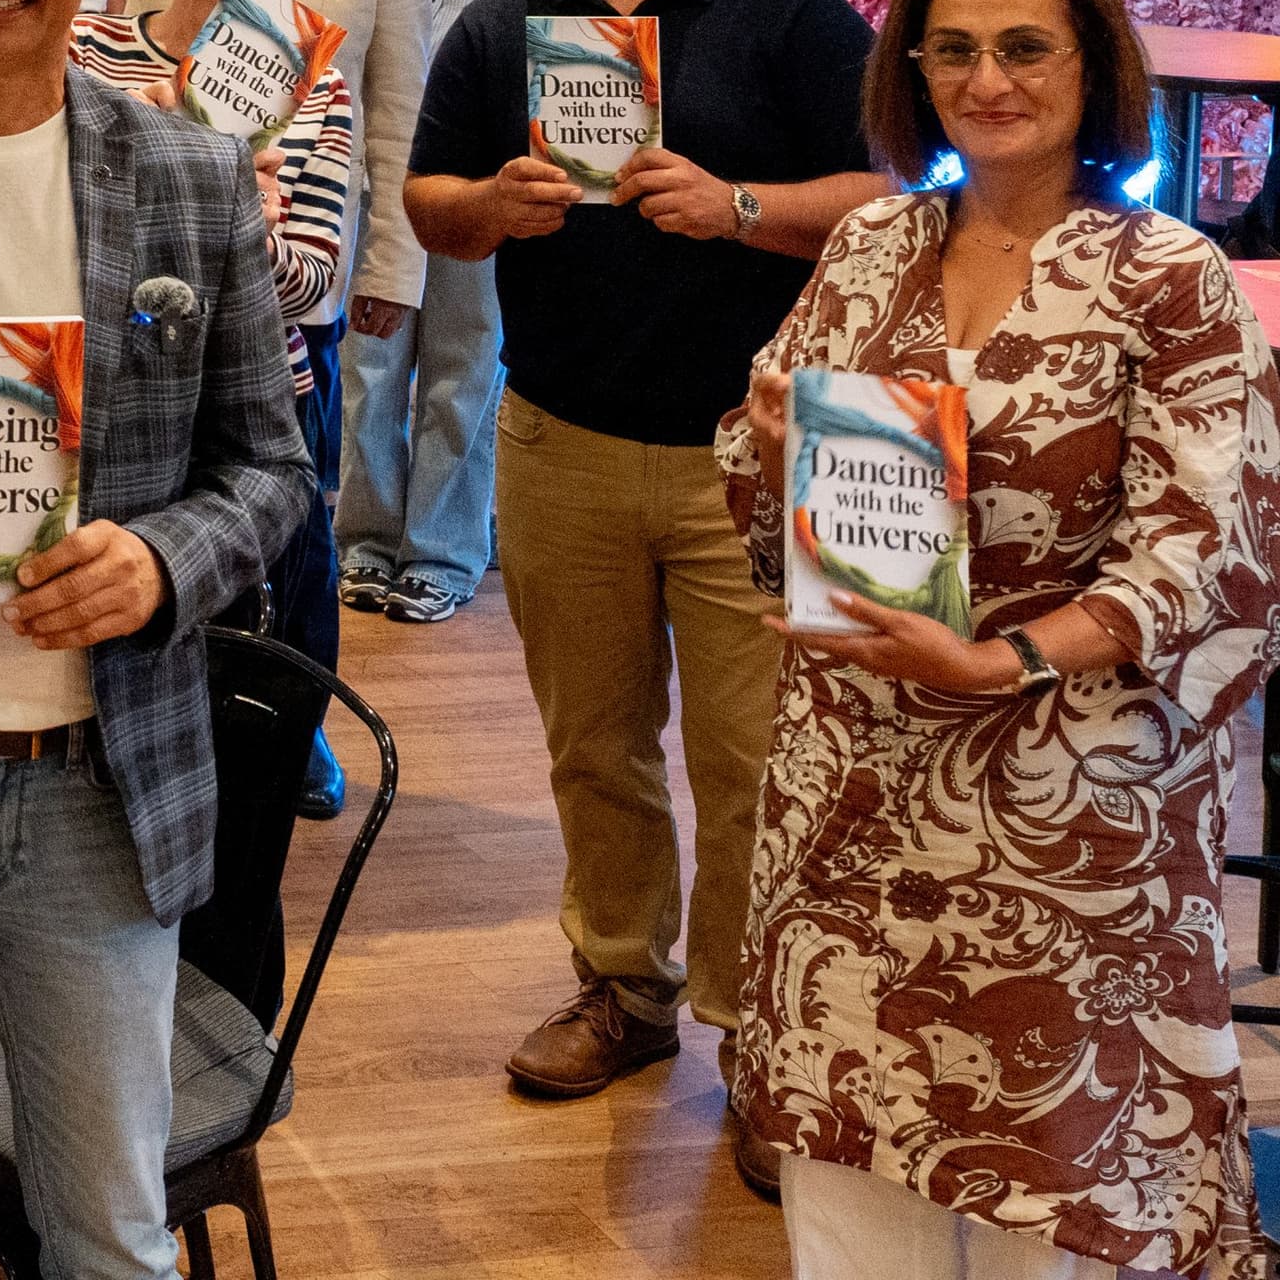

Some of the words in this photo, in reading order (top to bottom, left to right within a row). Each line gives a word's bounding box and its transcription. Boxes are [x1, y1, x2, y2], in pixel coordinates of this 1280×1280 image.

[208, 22, 302, 96] Dancing
[216, 57, 248, 83] with
[249, 72, 274, 99] the
[187, 60, 278, 130] Universe
[540, 73, 646, 105] Dancing
[559, 101, 595, 118] with
[600, 101, 627, 118] the
[540, 120, 648, 145] Universe
[811, 447, 948, 501] Dancing
[835, 488, 881, 513] with
[889, 492, 924, 516] the
[810, 511, 951, 555] Universe
